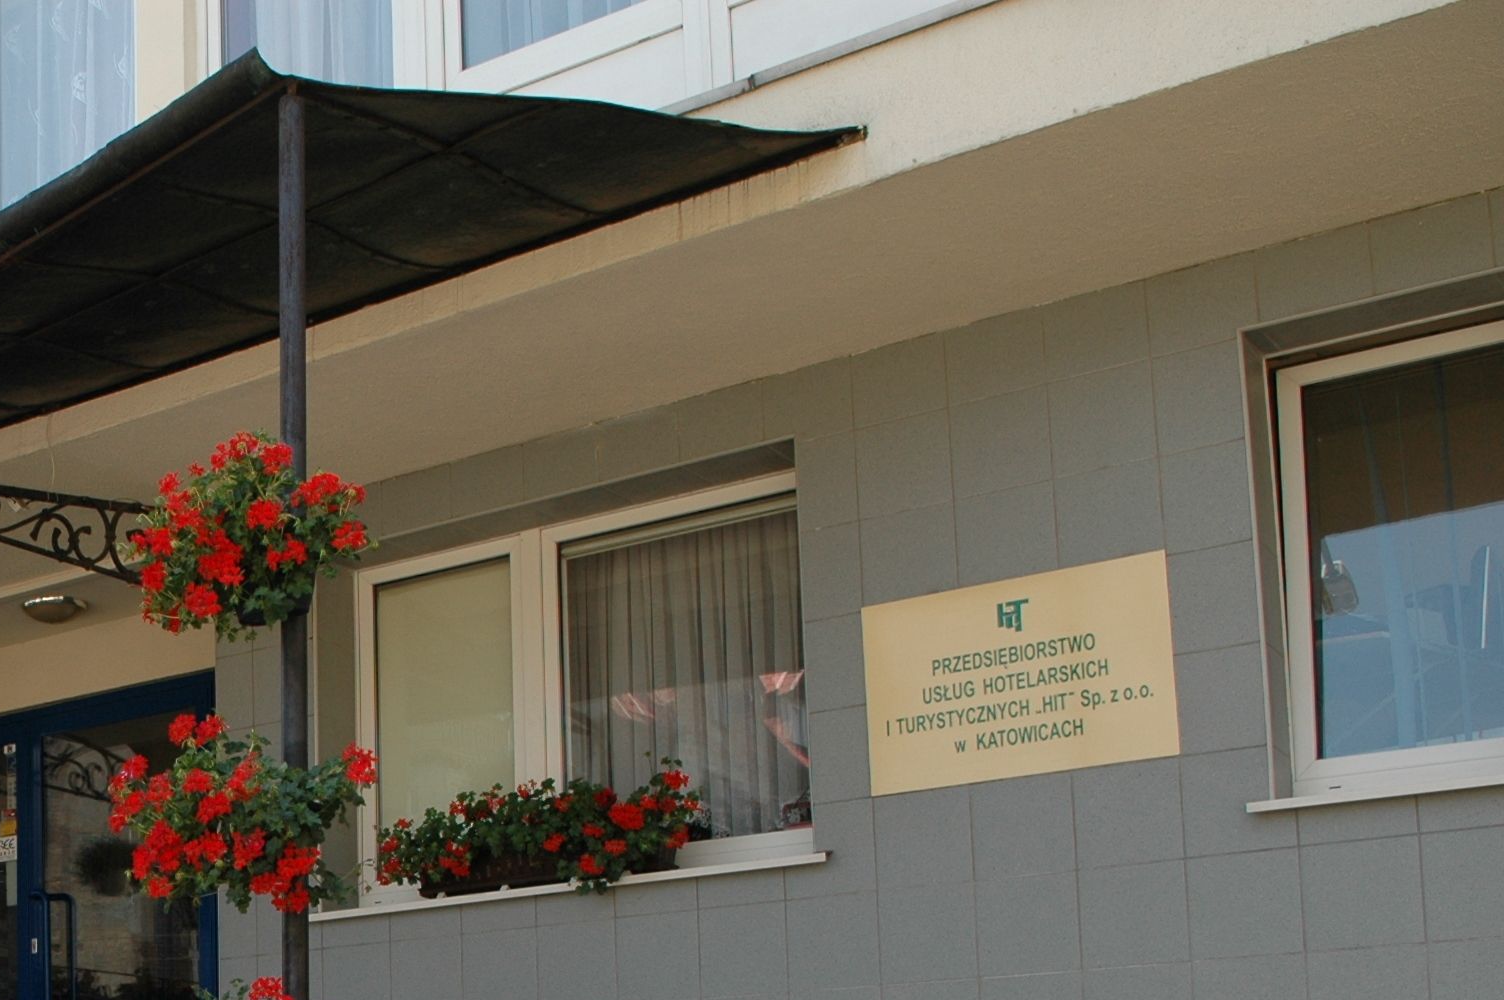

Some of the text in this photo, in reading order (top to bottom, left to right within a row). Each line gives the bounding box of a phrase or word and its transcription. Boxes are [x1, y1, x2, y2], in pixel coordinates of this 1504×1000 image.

[932, 633, 1096, 677] PRZEDSIĘBIORSTWO
[922, 658, 1109, 704] USŁUG HOTELARSKICH
[886, 720, 890, 736] I
[896, 699, 1030, 735] TURYSTYCZNYCH
[1080, 689, 1106, 710] Sp.
[1110, 689, 1119, 703] z
[1123, 685, 1154, 700] o.o.
[954, 718, 1084, 753] w KATOWICACH
